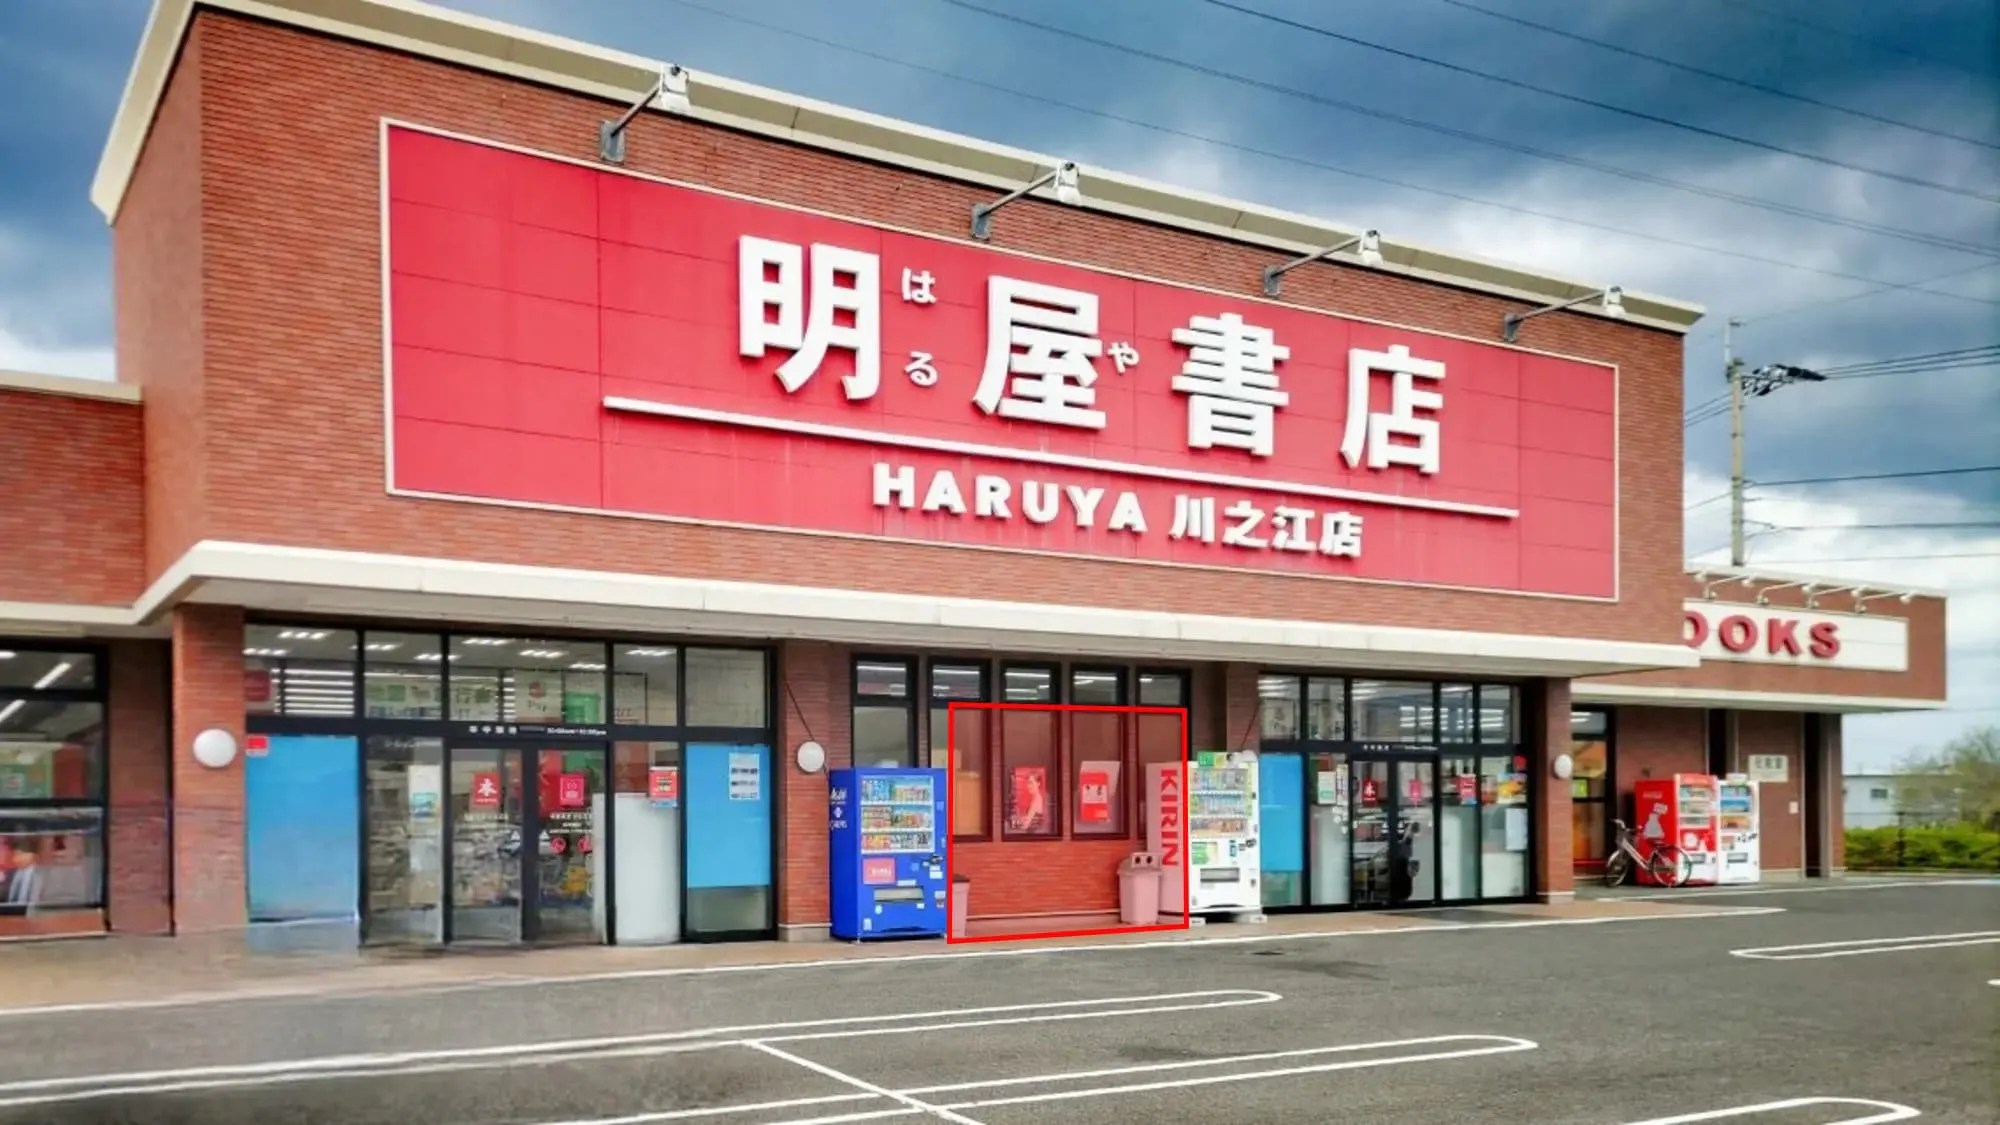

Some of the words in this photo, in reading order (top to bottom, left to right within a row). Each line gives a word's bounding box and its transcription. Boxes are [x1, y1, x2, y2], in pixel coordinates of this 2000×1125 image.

[738, 234, 1447, 475] 明屋書店
[1108, 341, 1141, 374] や
[873, 462, 1149, 534] HARUYA
[1169, 494, 1364, 560] 川之江店
[1160, 768, 1179, 867] KIRIN
